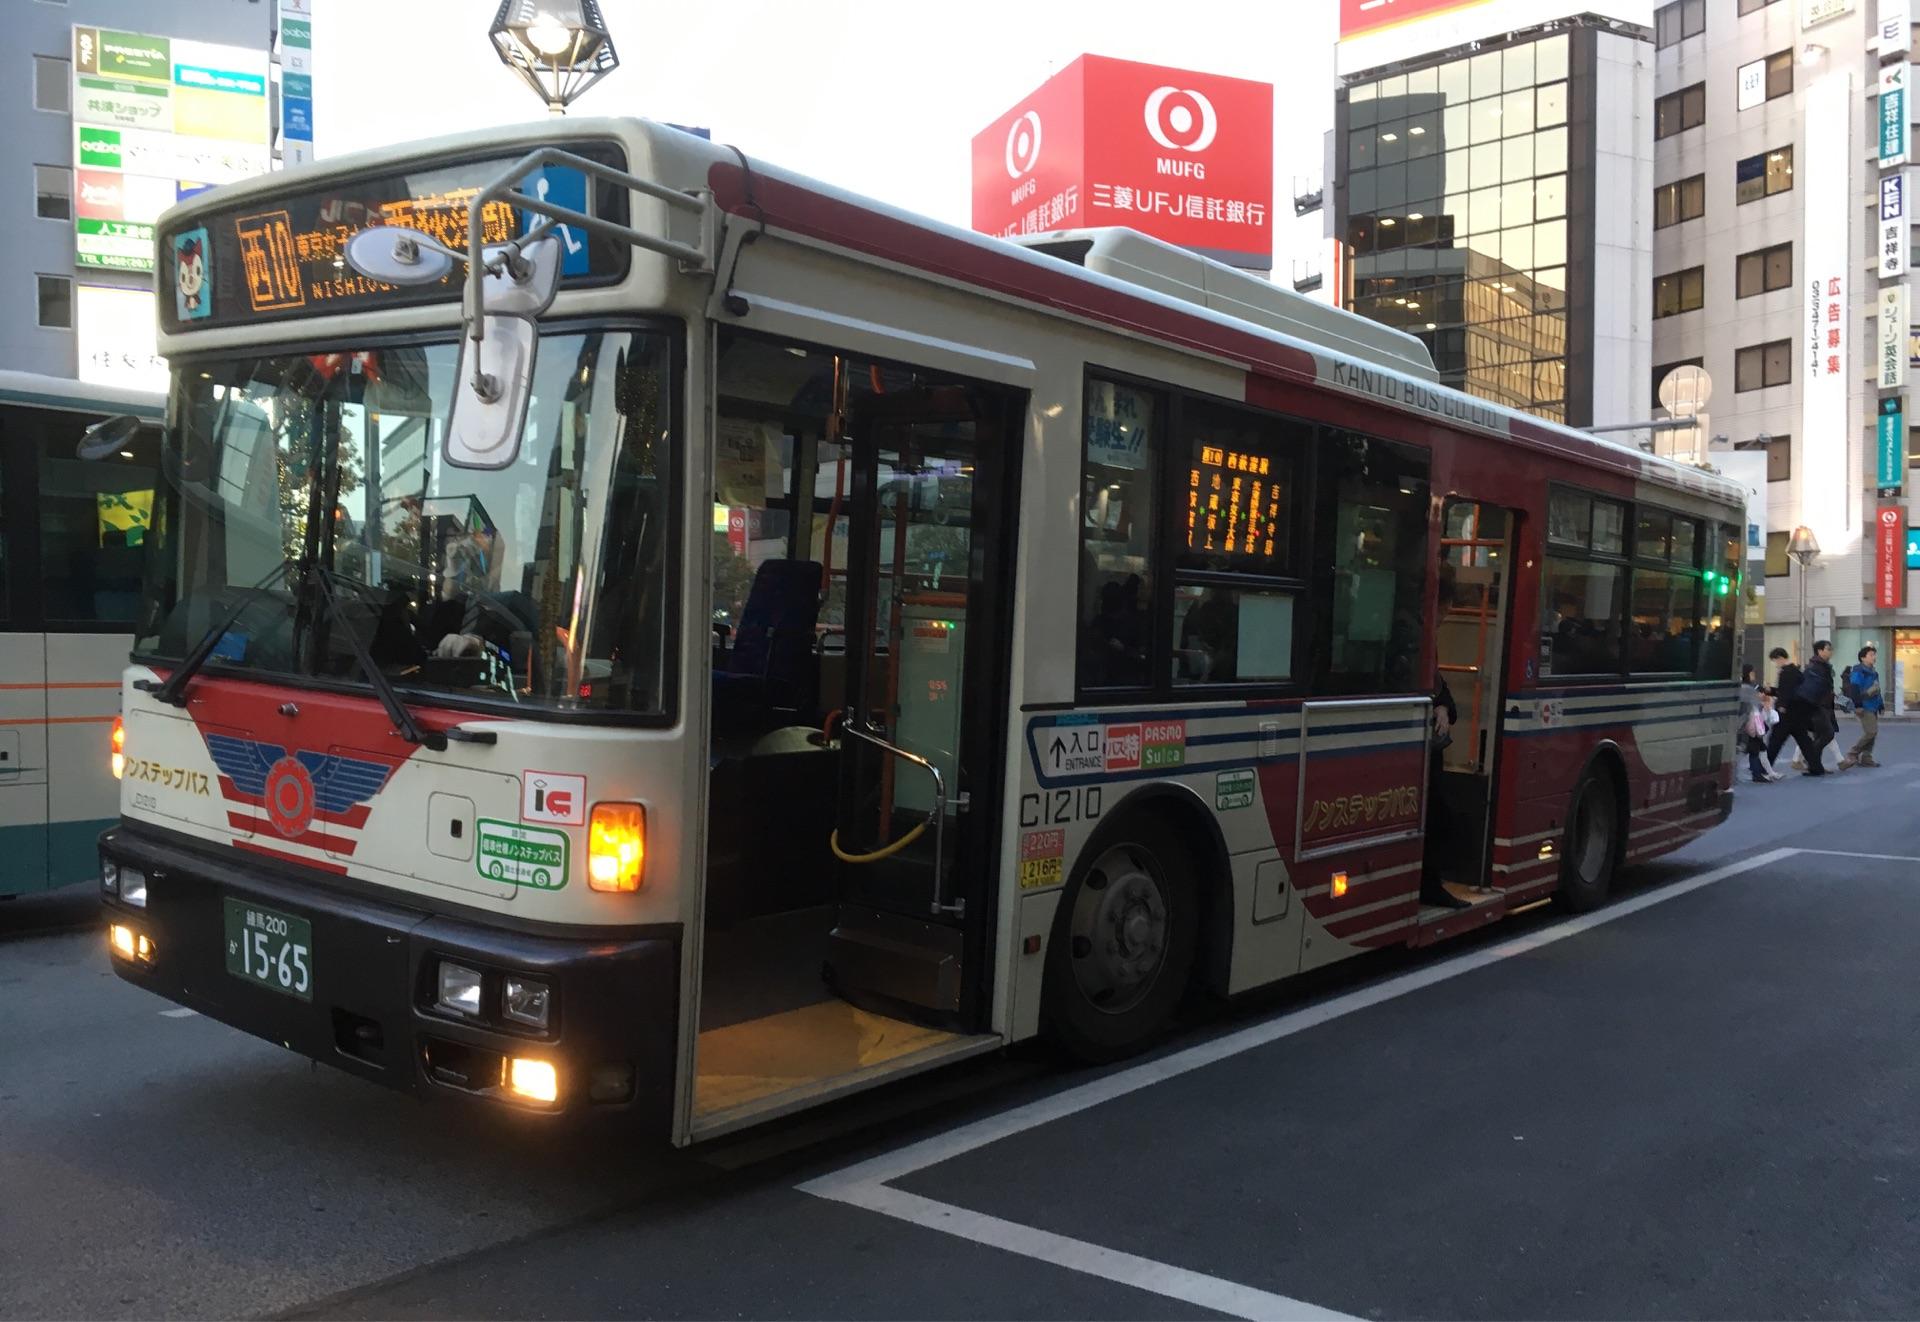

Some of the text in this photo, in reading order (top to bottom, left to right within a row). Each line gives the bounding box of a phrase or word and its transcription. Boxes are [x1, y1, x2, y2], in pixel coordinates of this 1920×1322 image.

[87, 98, 162, 117] 共済ショップ
[1157, 158, 1205, 179] MUFG
[1011, 178, 1036, 205] MUFG
[1093, 183, 1265, 226] 三菱UFJ信託銀行
[1884, 179, 1900, 218] KEN
[239, 221, 298, 301] 西10
[1333, 360, 1397, 400] KANTO
[1404, 382, 1439, 412] BUS
[1070, 731, 1099, 753] 入口
[1145, 725, 1182, 741] PASMO
[1065, 755, 1103, 771] ENTRANCE
[1146, 748, 1180, 764] Suica
[122, 757, 210, 796] ノンステップバス
[1020, 787, 1102, 828] C1210
[1304, 786, 1418, 833] ノンステップバス
[1030, 832, 1059, 850] 220円
[243, 927, 309, 993] 15-65
